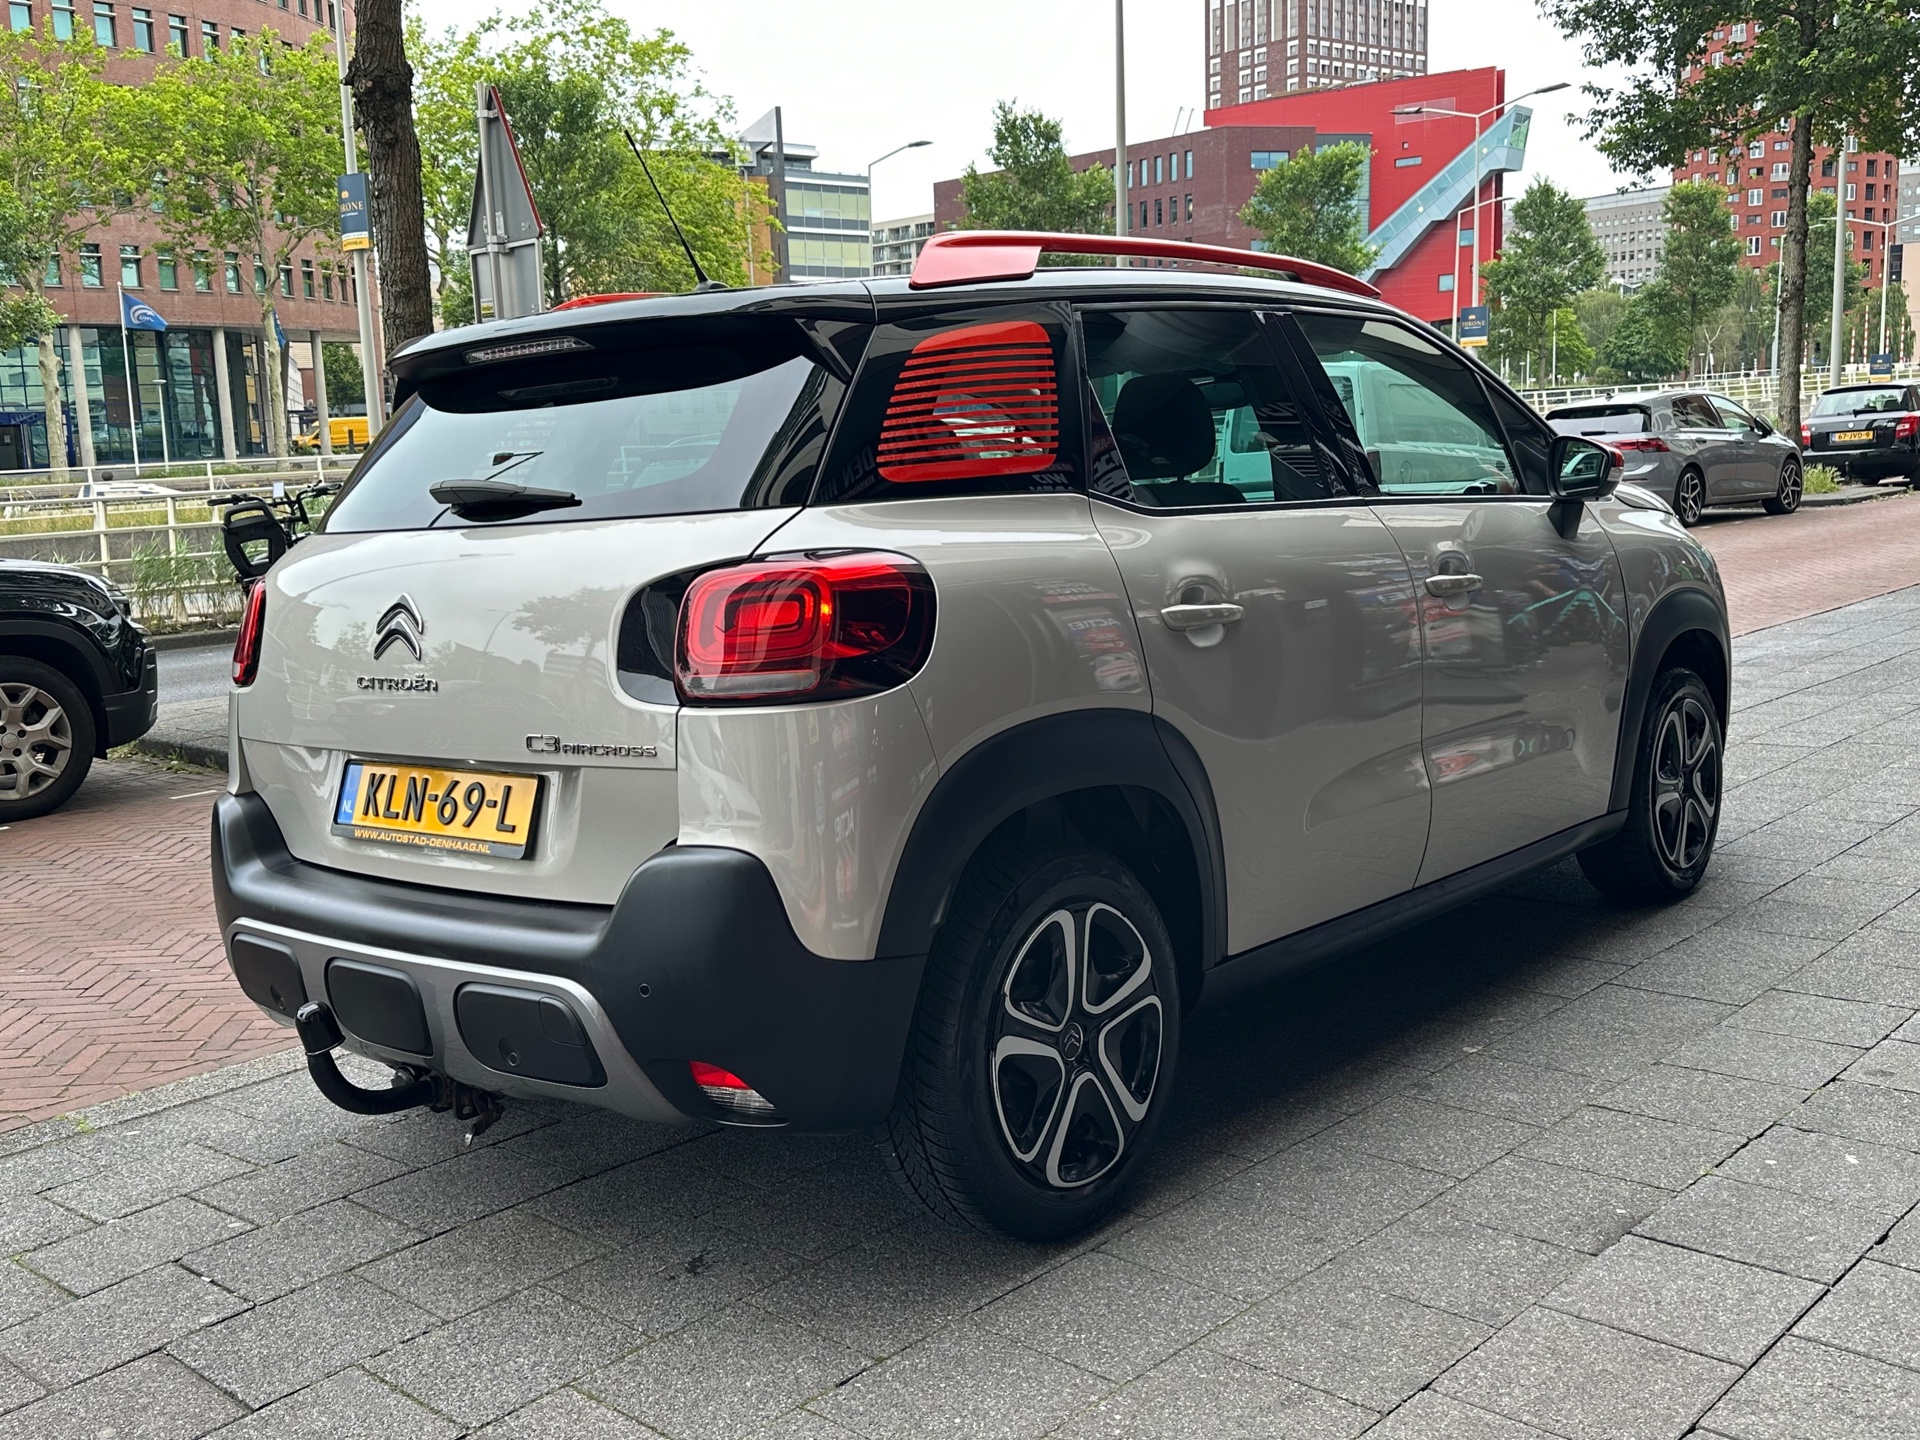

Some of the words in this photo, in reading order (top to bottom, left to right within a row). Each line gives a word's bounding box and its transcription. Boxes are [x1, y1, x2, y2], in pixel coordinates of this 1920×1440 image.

[1838, 432, 1871, 440] 67-JVD-9
[525, 733, 561, 754] C3
[561, 742, 658, 758] AIRCROSS
[342, 800, 353, 813] NL
[362, 772, 517, 833] KLN-69-L
[354, 828, 492, 854] WWW.AUTOSTAD-DENHAAG.NL
